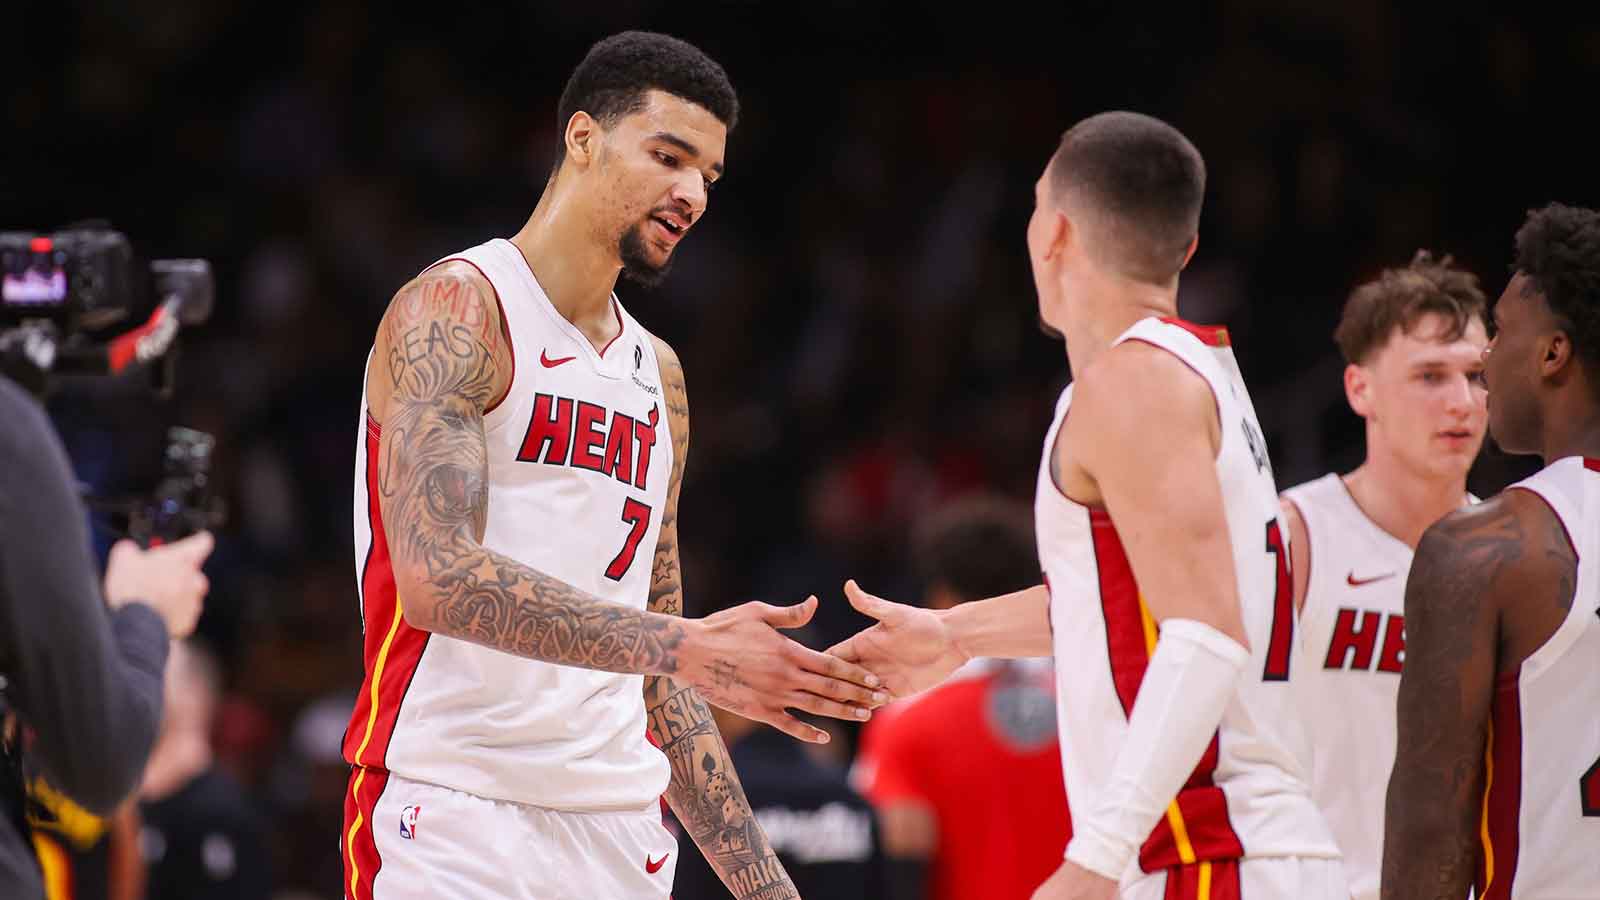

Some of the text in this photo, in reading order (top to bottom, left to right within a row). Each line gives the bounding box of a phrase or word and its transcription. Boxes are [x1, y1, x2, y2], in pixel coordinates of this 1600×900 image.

[389, 318, 496, 386] BEAST
[516, 392, 660, 491] HEAT
[604, 496, 652, 582] 7
[1262, 515, 1294, 682] 1
